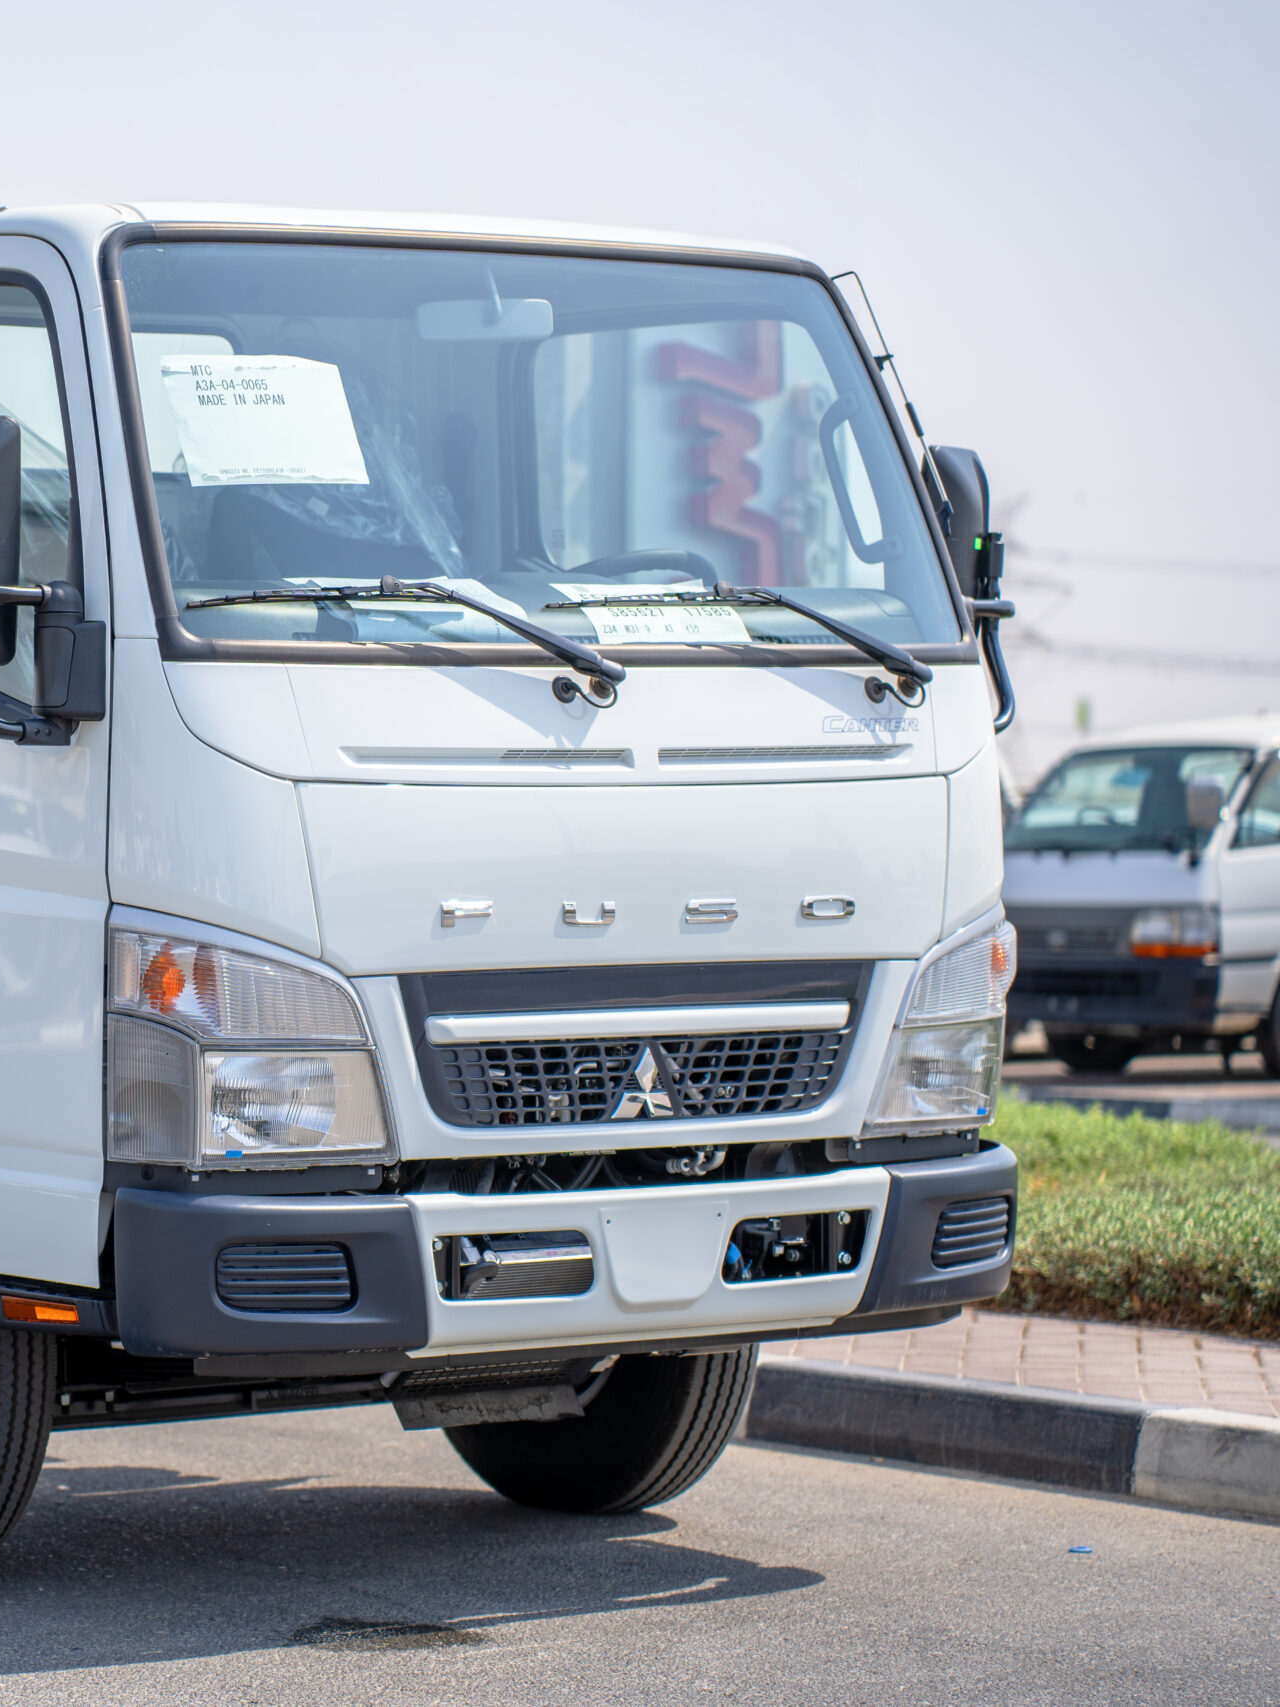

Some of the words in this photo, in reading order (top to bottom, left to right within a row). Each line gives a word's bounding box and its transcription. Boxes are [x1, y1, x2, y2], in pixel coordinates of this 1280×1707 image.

[190, 364, 212, 376] MTC
[195, 379, 268, 391] A3A-04-0065
[198, 393, 227, 406] MADE
[233, 393, 247, 405] IN
[253, 393, 285, 405] JAPAN
[822, 715, 919, 733] CANTER
[441, 895, 856, 927] FUSO
